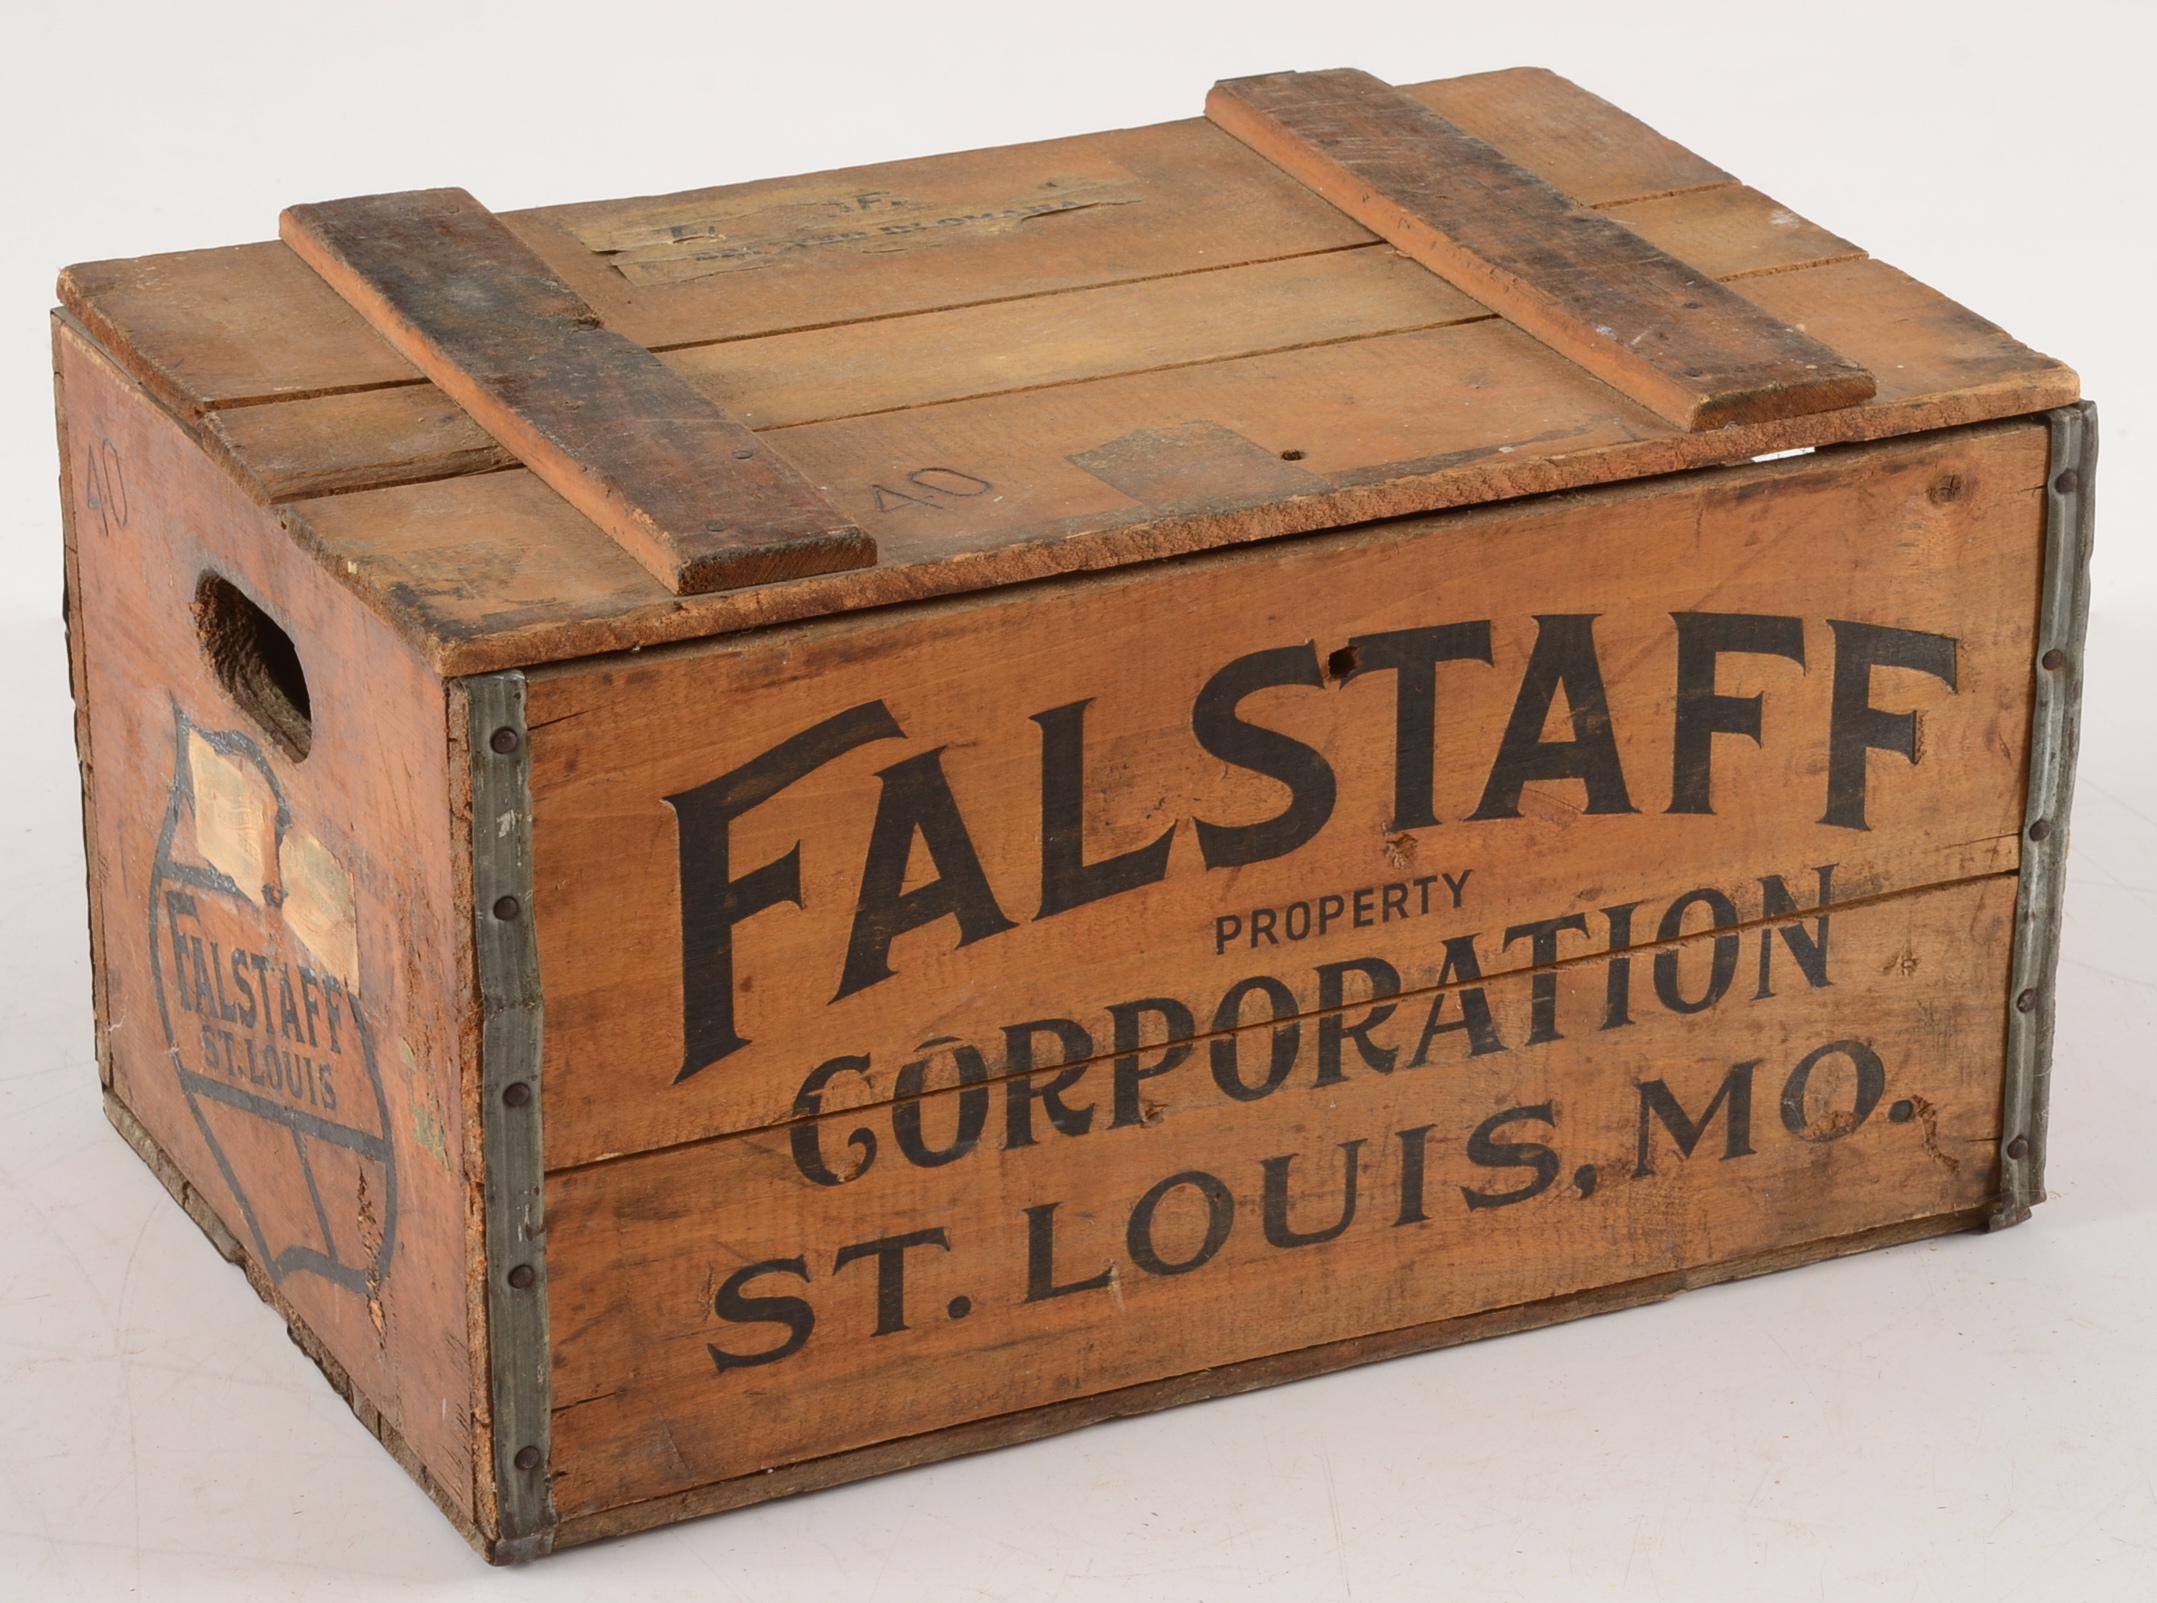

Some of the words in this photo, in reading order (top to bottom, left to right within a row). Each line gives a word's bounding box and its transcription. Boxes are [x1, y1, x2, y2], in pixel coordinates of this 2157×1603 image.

[164, 890, 343, 1054] FALSTAFF
[660, 611, 1958, 1086] FALSTAFF
[1215, 867, 1474, 955] PROPERTY
[789, 862, 1841, 1187] CORPORATION
[706, 1226, 972, 1374] ST.
[1022, 1101, 1599, 1304] LOUIS,
[1630, 1038, 1915, 1180] MO.
